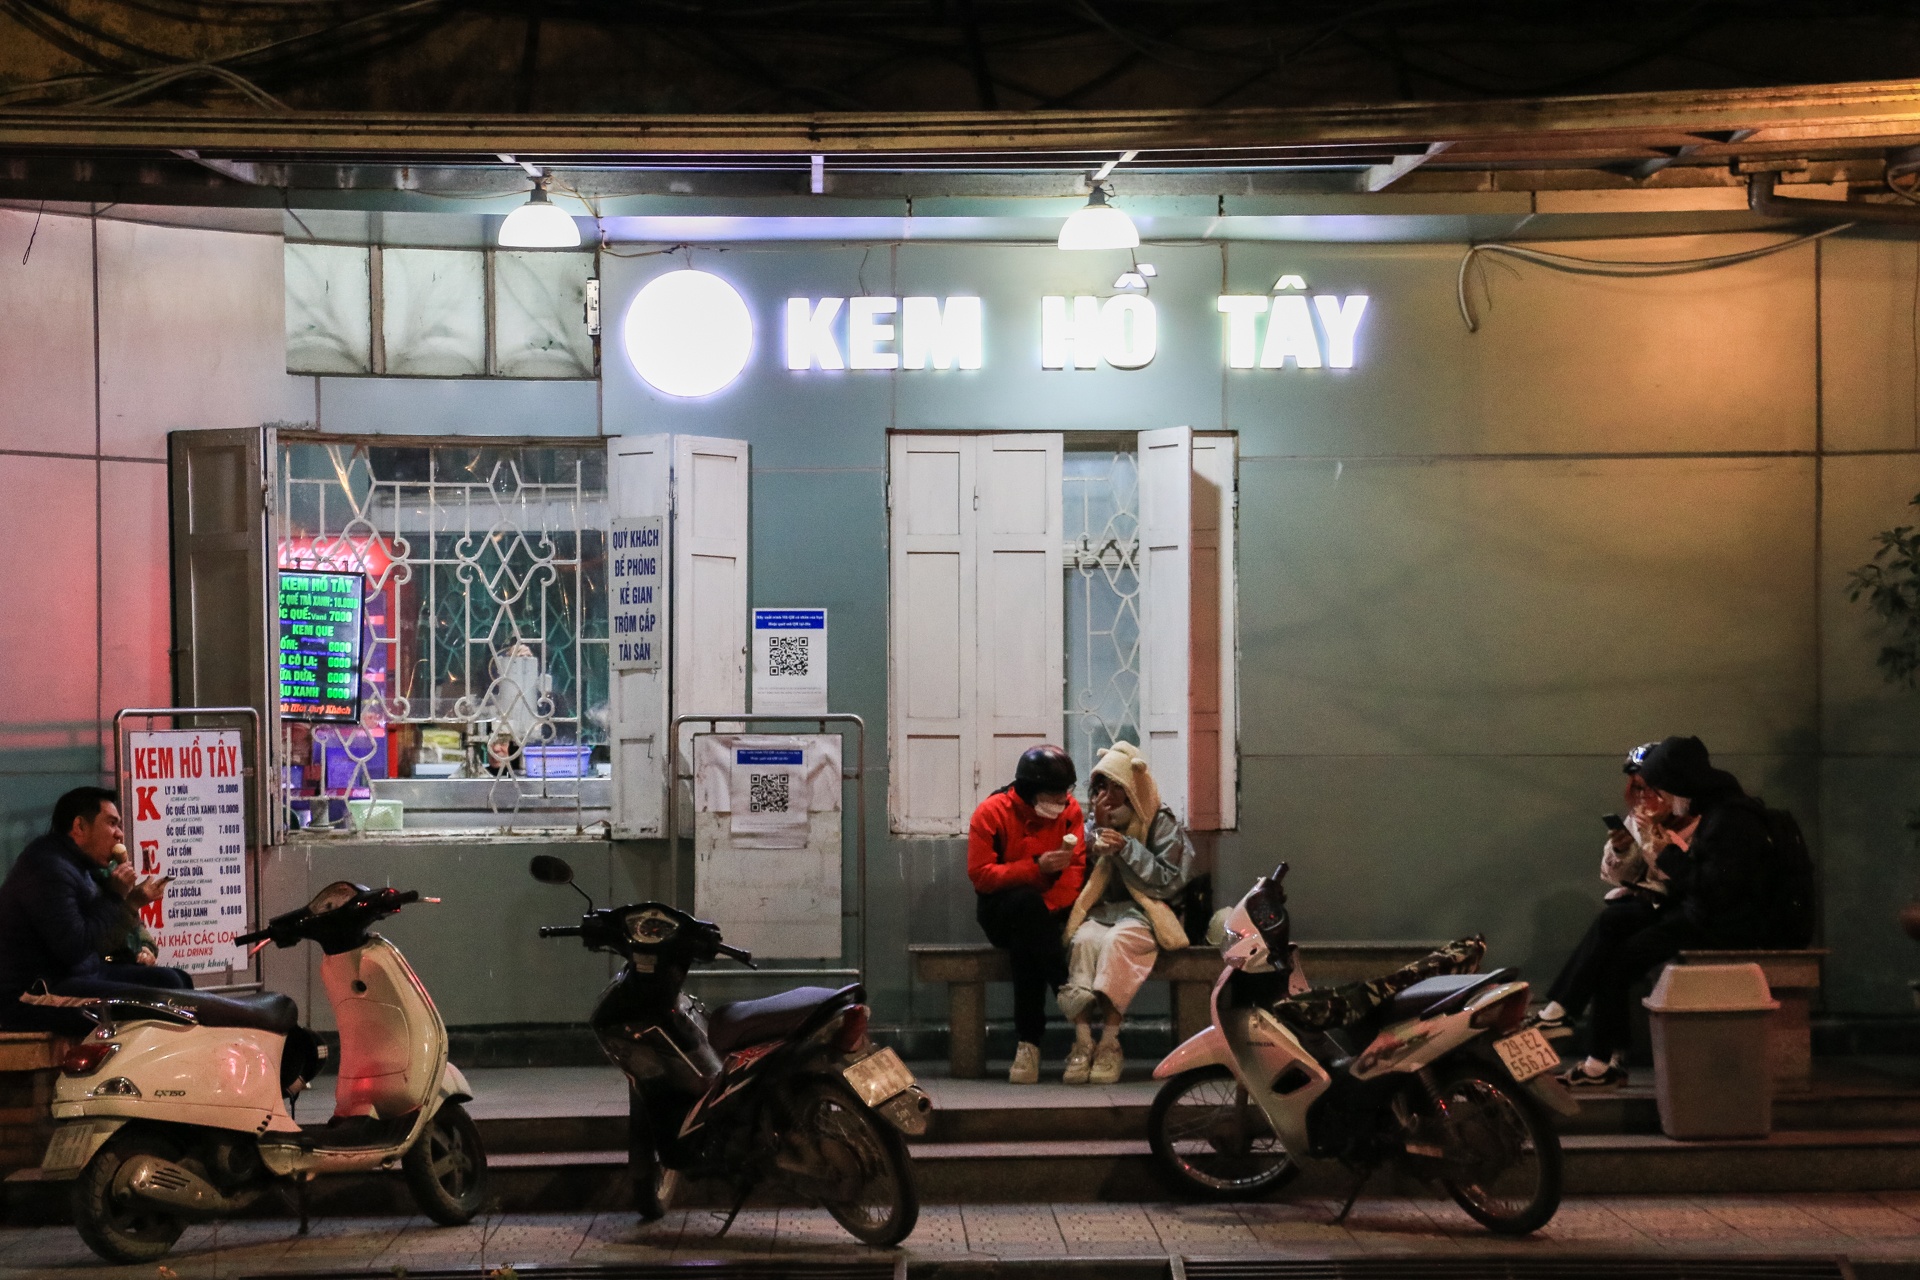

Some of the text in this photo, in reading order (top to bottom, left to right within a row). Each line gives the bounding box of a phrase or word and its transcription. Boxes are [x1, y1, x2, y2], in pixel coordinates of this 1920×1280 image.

[787, 263, 1369, 371] KEM HỒ TÂY
[613, 526, 659, 551] QUÝ KHÁCH
[627, 553, 656, 577] PHÒNG
[281, 576, 309, 591] KEM
[330, 576, 354, 593] TÂY
[620, 581, 653, 604] KẺ GIAN
[329, 611, 353, 622] 7000
[614, 608, 656, 637] TRỘM CẮP
[292, 624, 334, 637] KEM QUE
[328, 641, 352, 653] 6000
[618, 637, 651, 661] TÀI SẢN
[288, 653, 301, 665] CÔ
[303, 655, 318, 667] LA:
[327, 657, 352, 668] 6000
[327, 672, 351, 684] 6000
[292, 685, 320, 698] XANH
[326, 687, 350, 699] 6000
[134, 747, 174, 779] KEM
[207, 739, 237, 777] TÂY
[164, 785, 171, 795] LY
[172, 785, 176, 795] 3
[165, 803, 173, 816] ỐC
[174, 803, 185, 816] QUẾ
[187, 804, 199, 816] (TRÀ
[200, 804, 217, 815] XANH)
[166, 824, 173, 836] ỐC
[175, 823, 186, 836] QUẾ
[188, 826, 204, 836] (VANI)
[166, 845, 177, 857] CÂY
[179, 844, 191, 857] CỐM
[168, 887, 178, 898] CÂY
[168, 907, 179, 919] CÂY
[193, 907, 208, 917] XANH
[168, 930, 192, 947] KHÁT
[194, 930, 215, 945] CÁC
[172, 947, 214, 958] ALL DRINKS
[1510, 1047, 1557, 1078] 556.21
